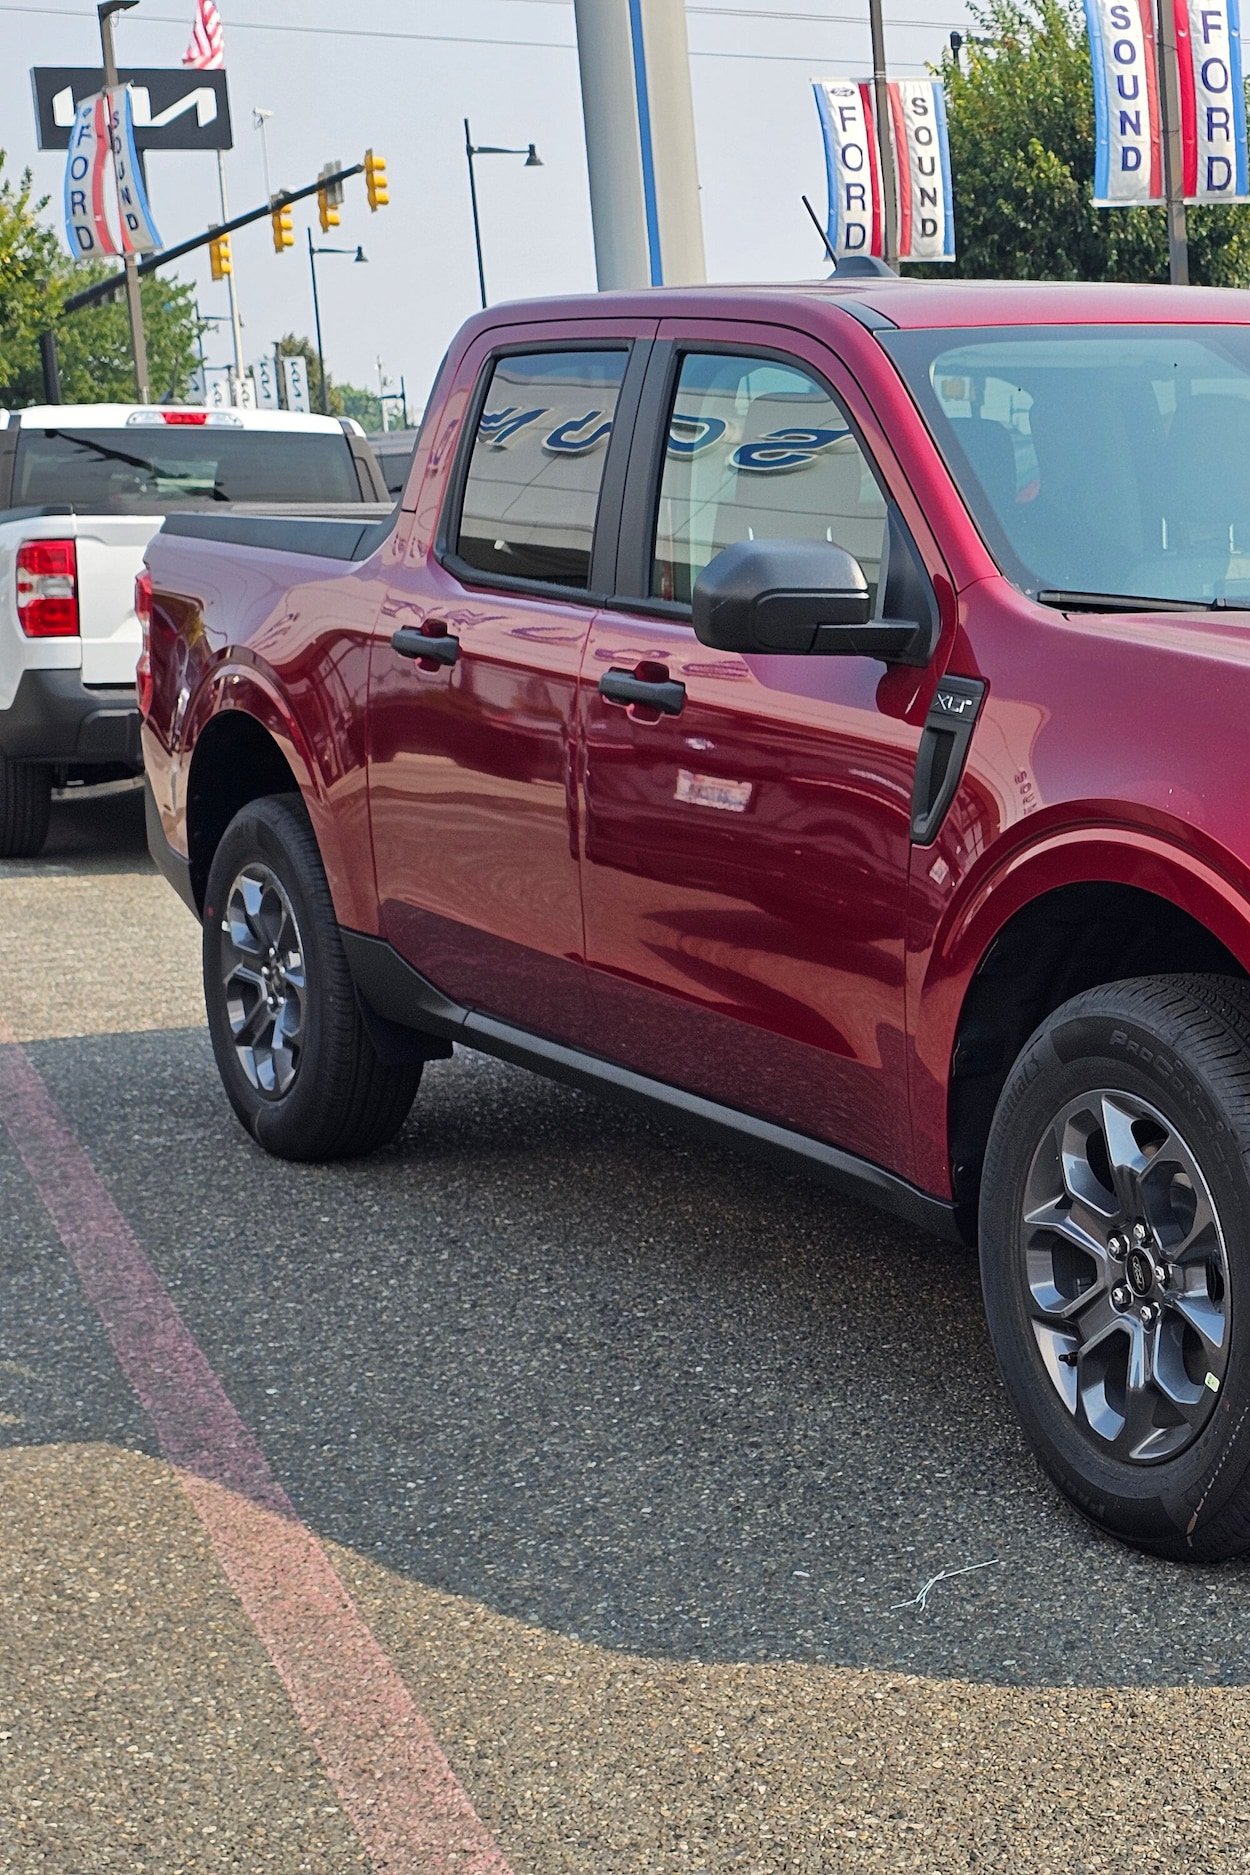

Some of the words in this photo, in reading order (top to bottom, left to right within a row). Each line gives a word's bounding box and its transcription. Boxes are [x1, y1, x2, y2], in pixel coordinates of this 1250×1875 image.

[1110, 5, 1142, 172] SOUND
[1201, 10, 1232, 192] FORD
[70, 125, 94, 251] FORD
[111, 111, 139, 231] SOUND
[838, 106, 866, 250] FORD
[911, 97, 938, 238] SOUND
[934, 693, 973, 714] XLT
